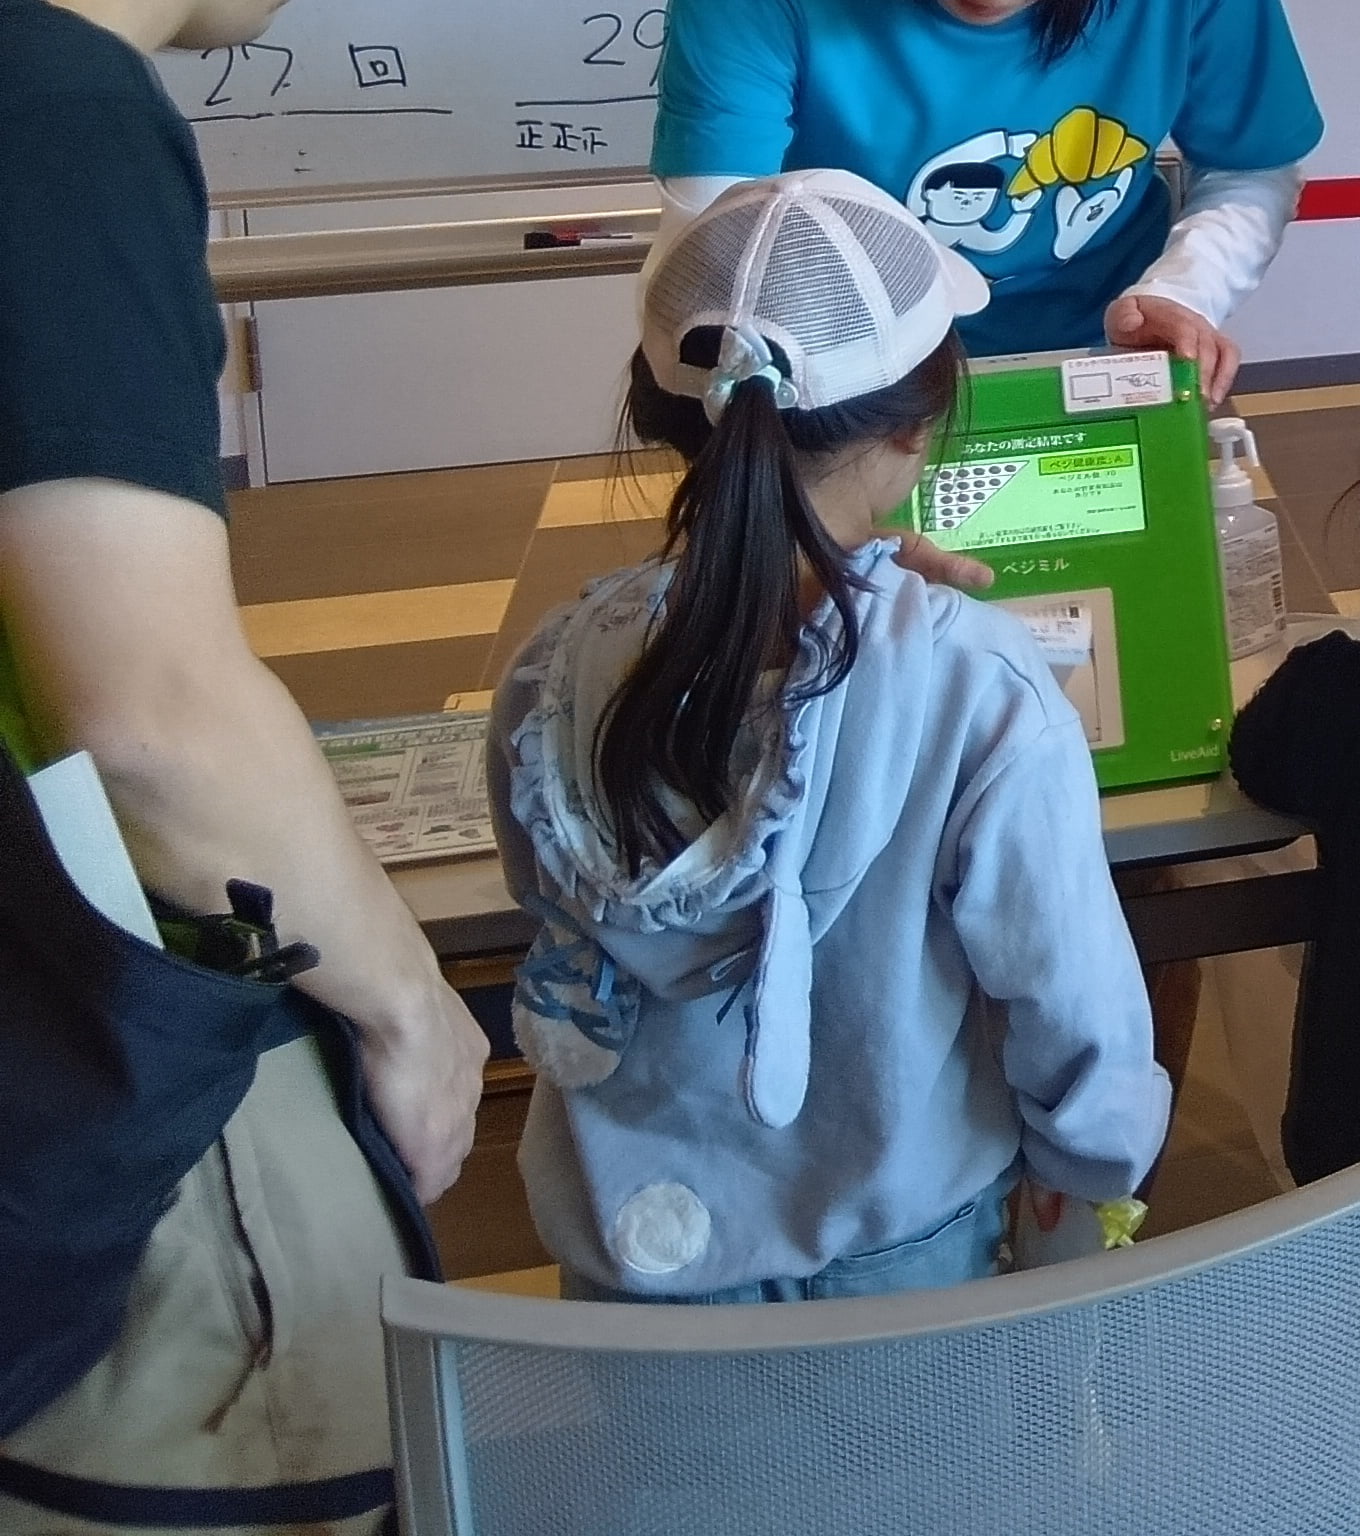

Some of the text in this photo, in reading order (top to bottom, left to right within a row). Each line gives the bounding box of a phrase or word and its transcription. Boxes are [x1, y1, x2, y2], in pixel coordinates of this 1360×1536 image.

[349, 43, 406, 87] 回
[1002, 557, 1070, 575] ベジミル
[1170, 743, 1220, 762] LiveAid
